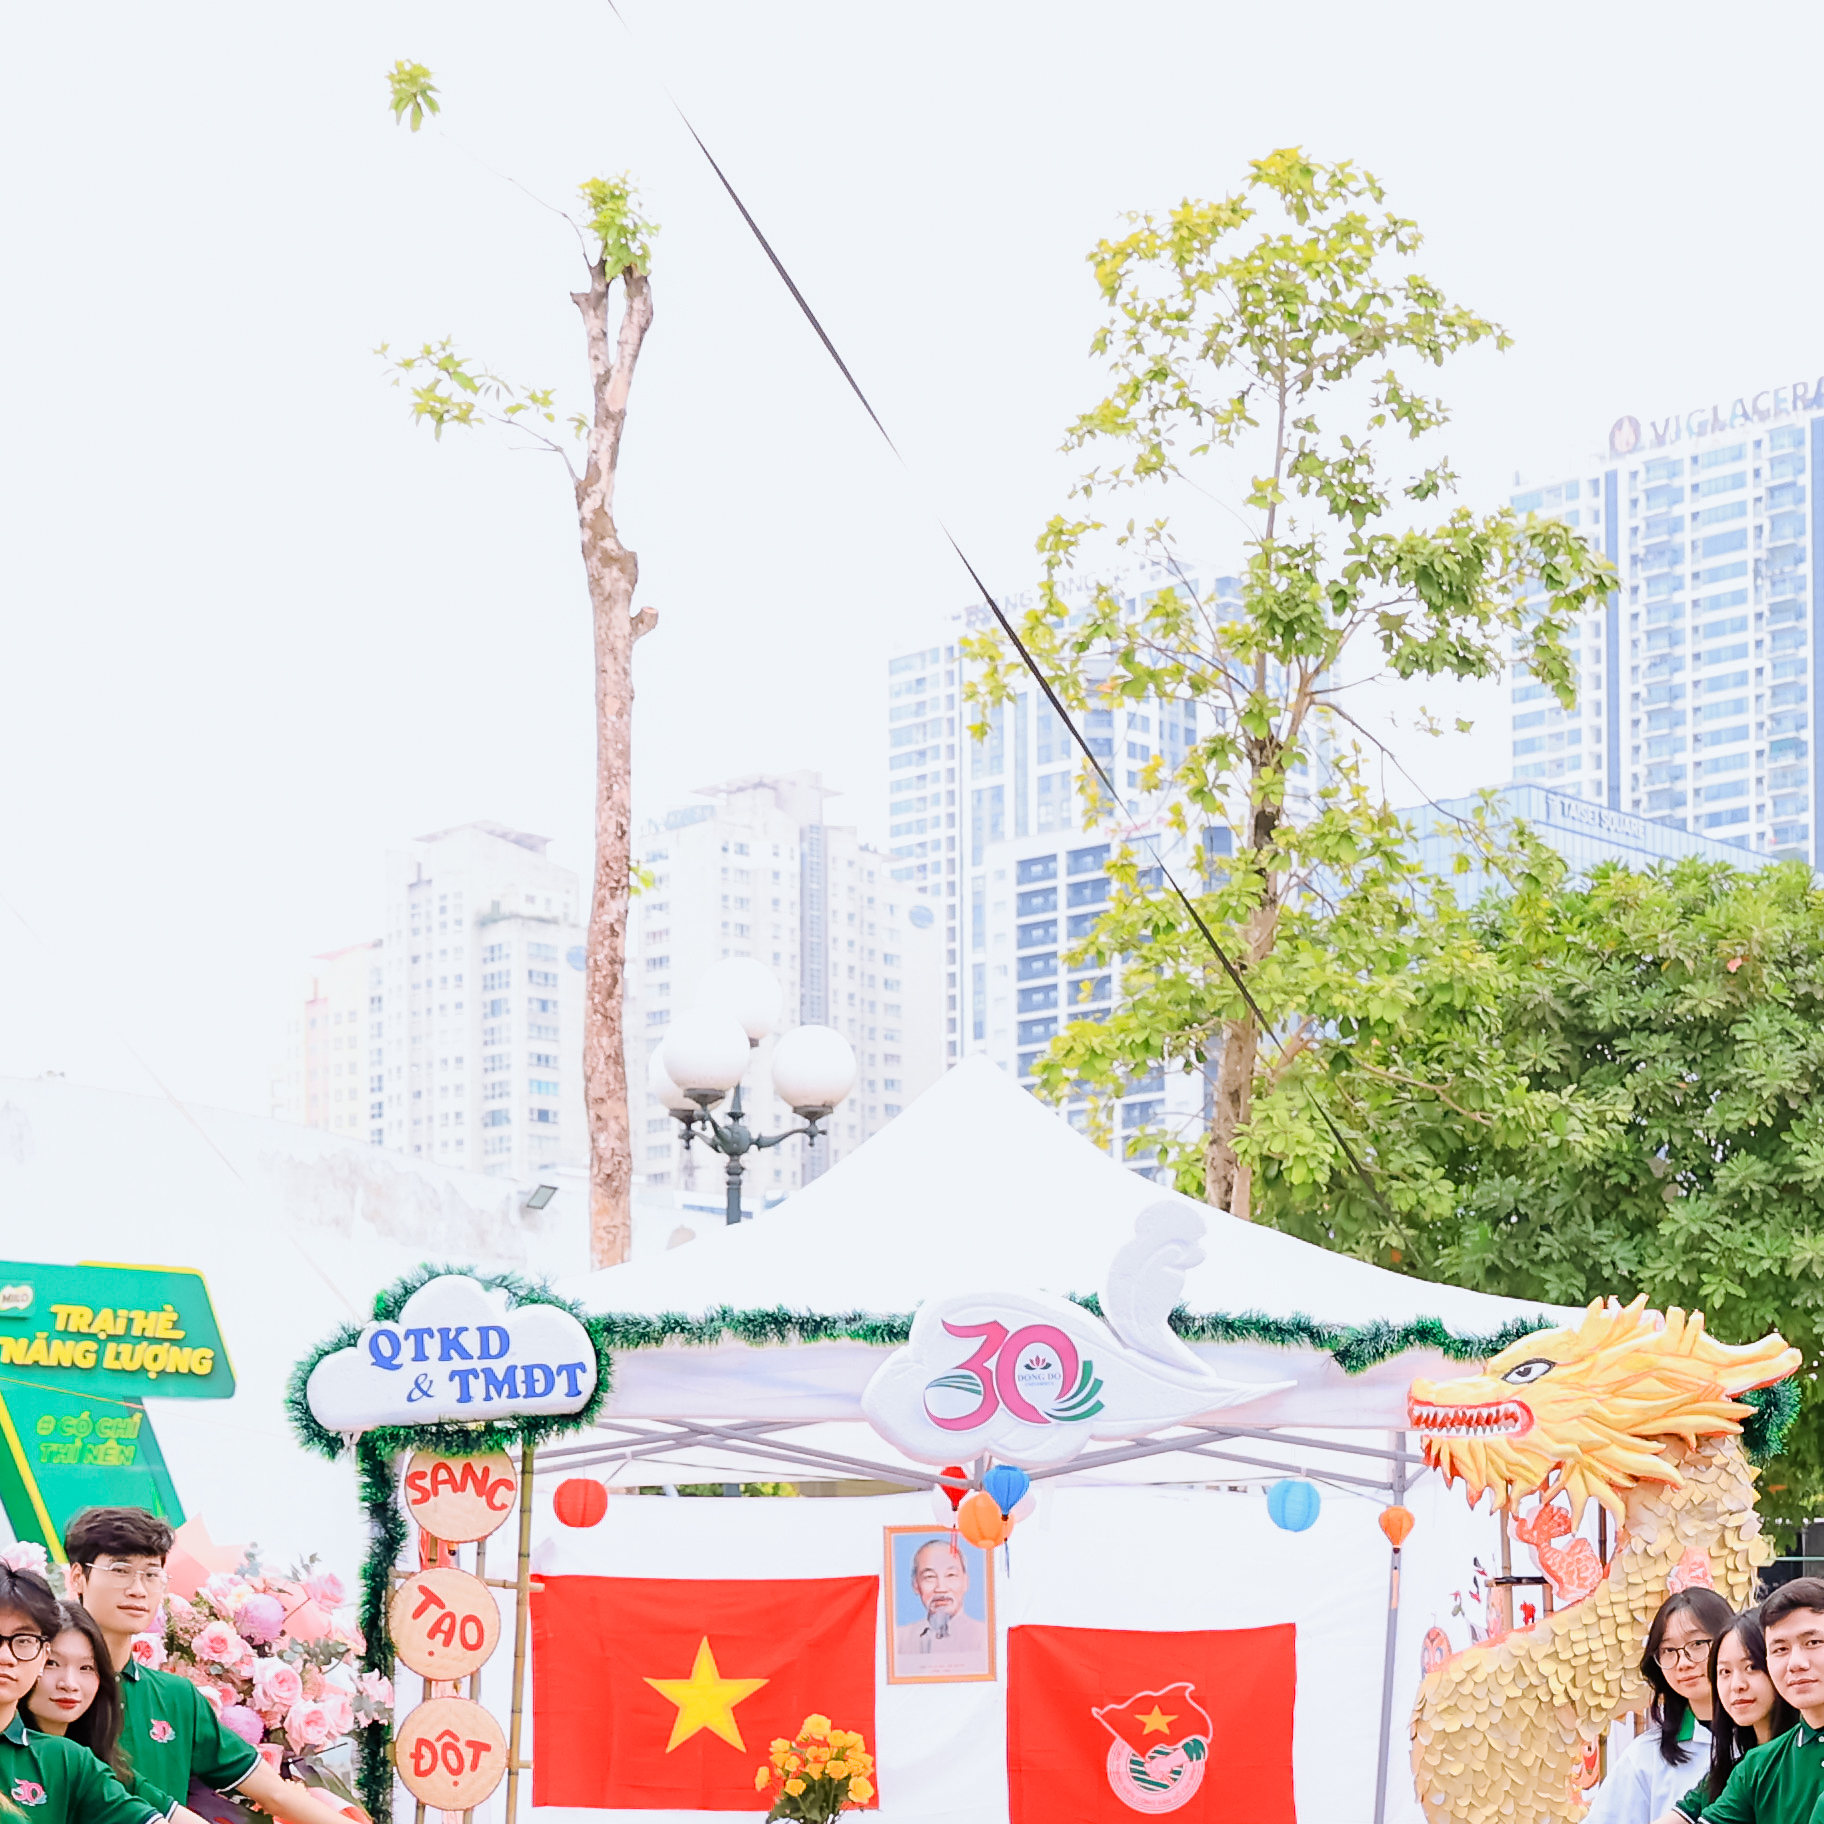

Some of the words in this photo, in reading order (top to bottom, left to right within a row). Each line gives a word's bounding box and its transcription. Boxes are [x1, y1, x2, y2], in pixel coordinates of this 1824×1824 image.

[49, 1304, 128, 1340] TRẠI
[130, 1303, 186, 1340] HÈ
[102, 1340, 215, 1380] LƯỢNG
[368, 1325, 511, 1371] QTKD
[406, 1373, 435, 1403] &
[448, 1362, 588, 1404] TMĐT
[923, 1320, 1079, 1432] 30
[412, 1584, 485, 1657] TẠO
[409, 1729, 492, 1787] ĐỘT
